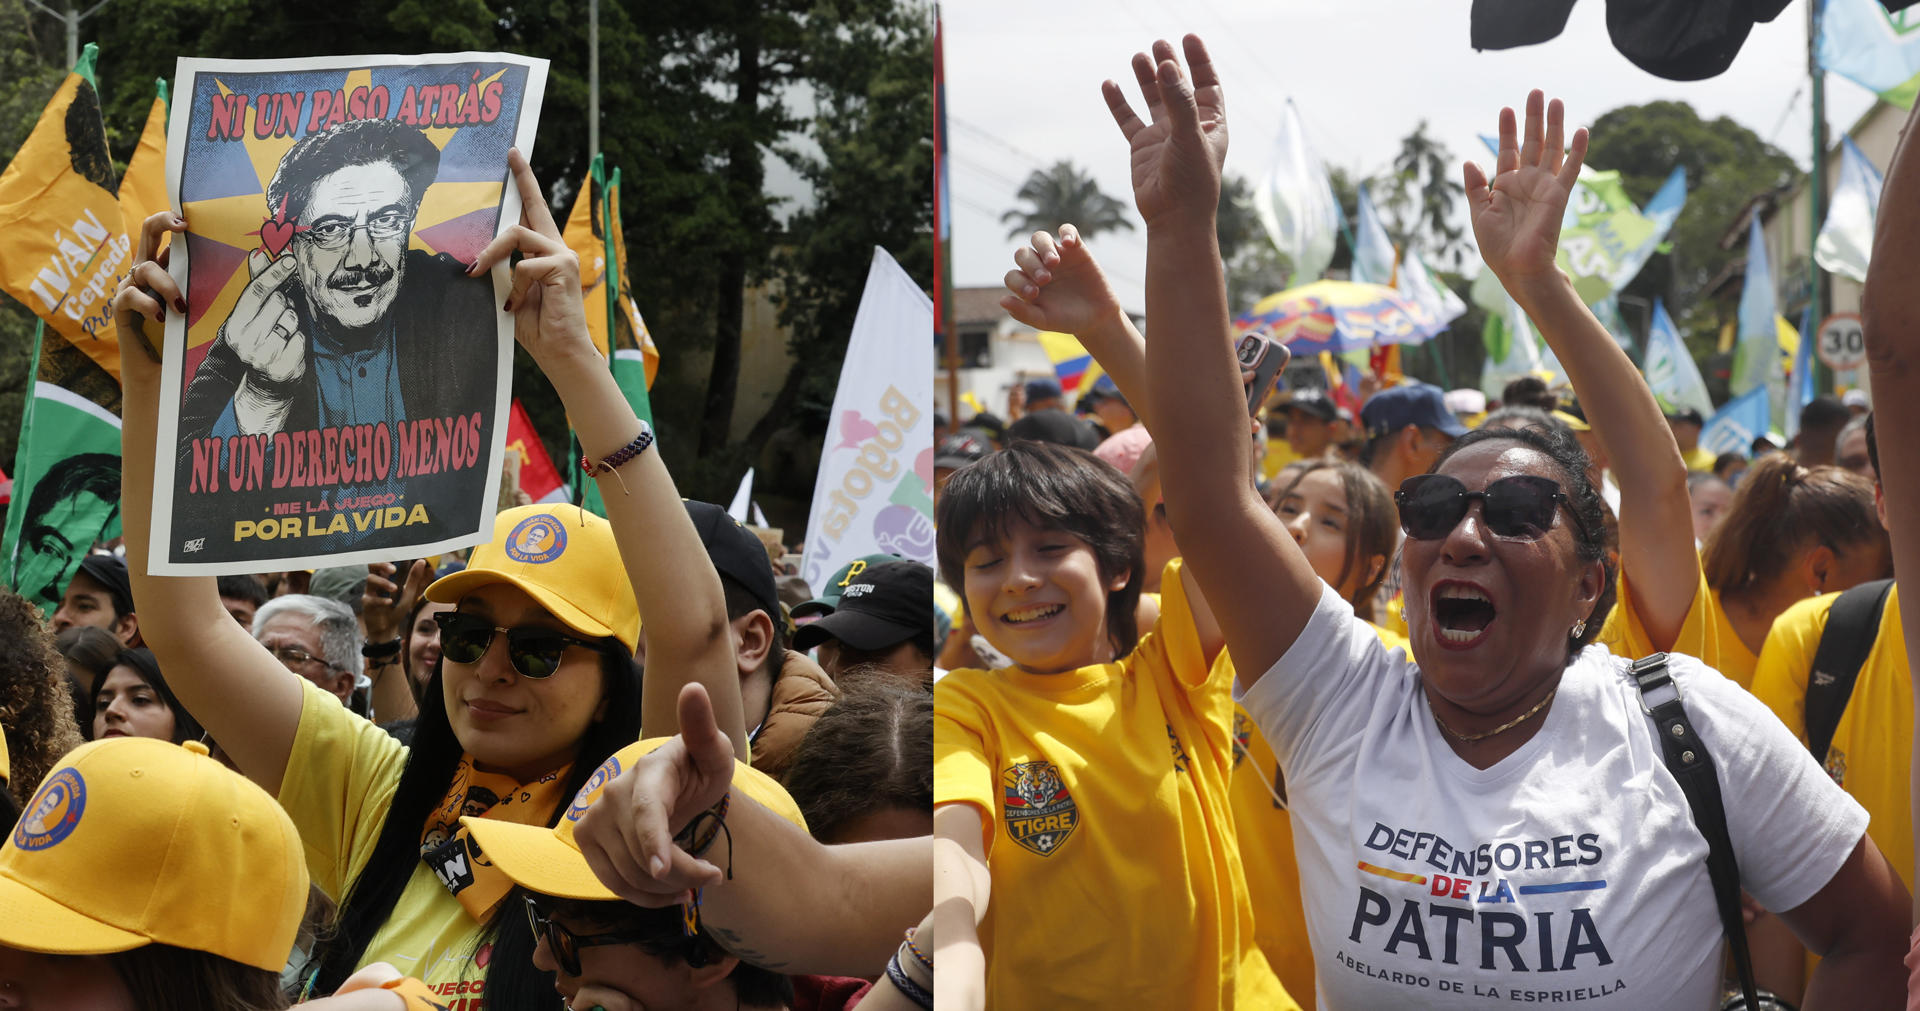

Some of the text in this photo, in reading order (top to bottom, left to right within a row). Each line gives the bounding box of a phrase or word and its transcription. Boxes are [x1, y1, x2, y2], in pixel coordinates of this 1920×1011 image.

[208, 68, 504, 140] NI UN PASO ATRÁS
[30, 207, 110, 313] IVÁN
[64, 233, 131, 321] Cepeda
[1826, 329, 1864, 354] 30
[189, 436, 221, 494] NI
[228, 434, 268, 492] UN
[271, 422, 391, 489] DERECHO
[396, 411, 482, 479] MENOS
[233, 503, 429, 542] POR LA VIDA
[273, 493, 396, 515] ME LA JUEGO
[837, 559, 867, 587] P
[28, 833, 53, 847] VIDA
[1013, 812, 1073, 838] TIGRE
[1364, 822, 1603, 877] DEFENSORES
[1430, 873, 1516, 904] DE LA
[1348, 885, 1614, 973] PATRIA
[1336, 950, 1627, 1003] ABELARDO DE LA ESPRIELLA
